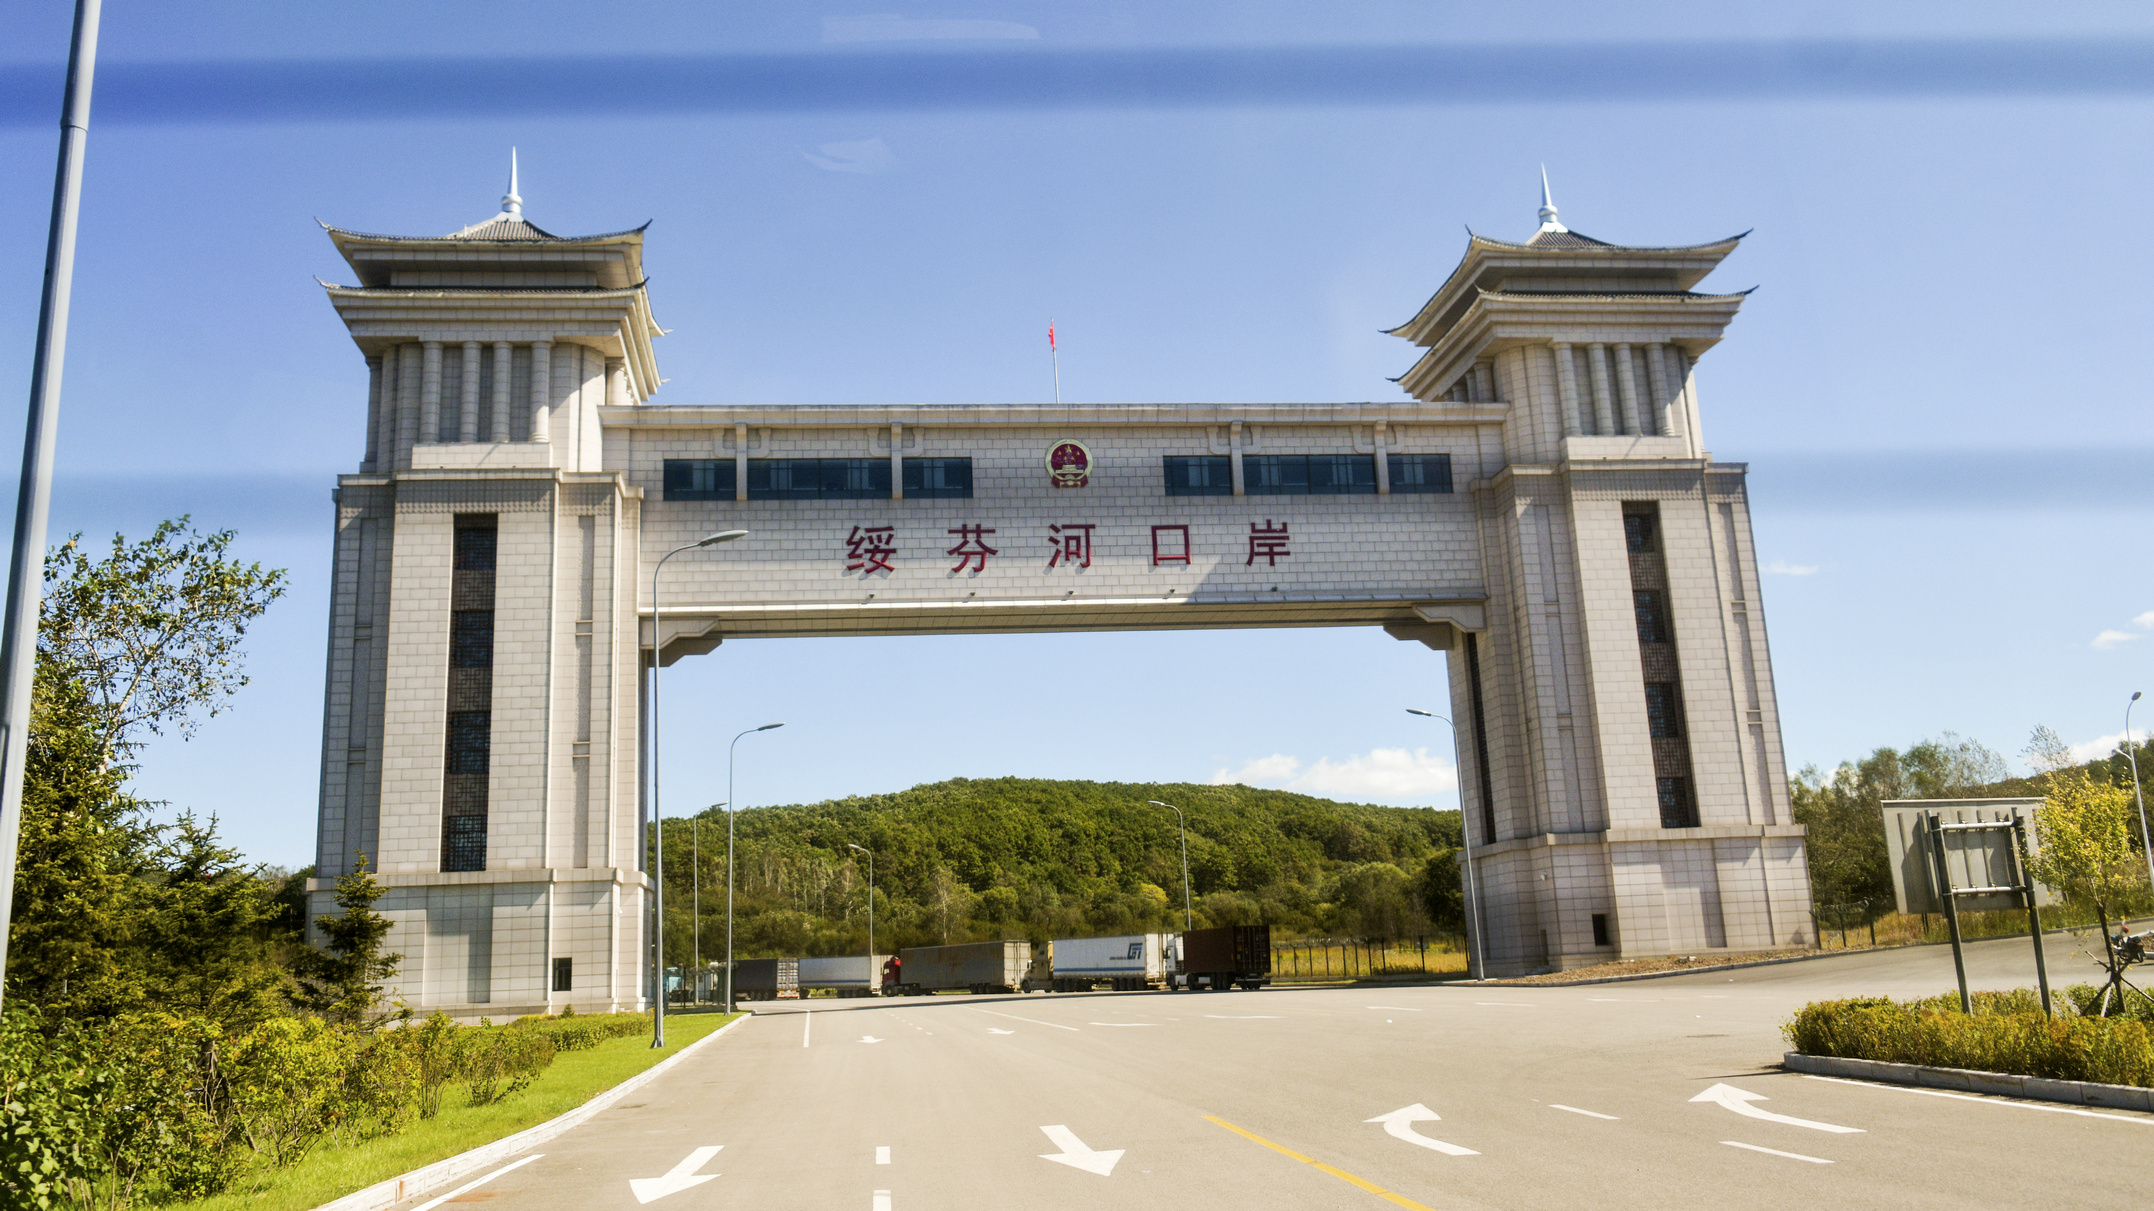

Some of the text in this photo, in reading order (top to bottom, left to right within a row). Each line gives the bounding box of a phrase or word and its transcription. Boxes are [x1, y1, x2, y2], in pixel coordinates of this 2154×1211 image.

[845, 518, 1291, 573] 绥芬河口岸
